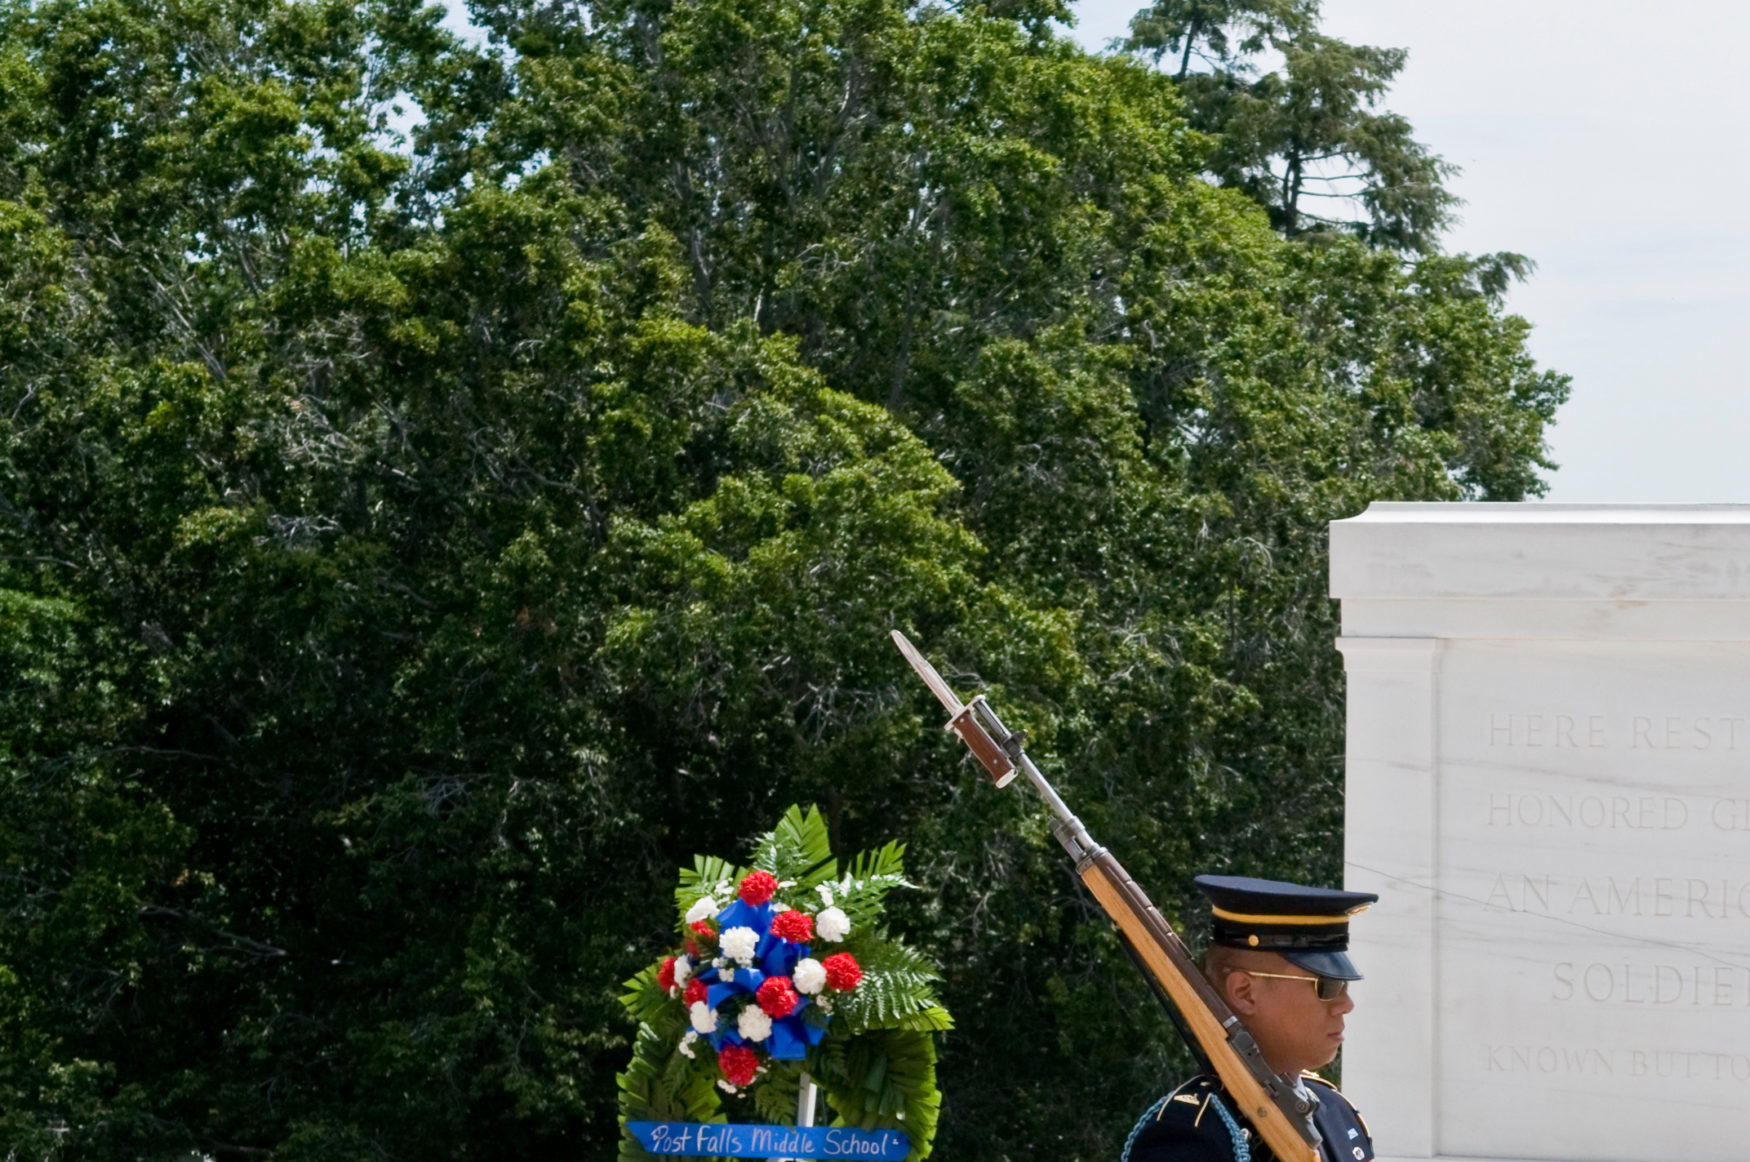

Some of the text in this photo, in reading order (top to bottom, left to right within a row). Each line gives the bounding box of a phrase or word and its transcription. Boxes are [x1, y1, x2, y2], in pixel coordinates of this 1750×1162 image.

[1488, 713, 1607, 749] HERE
[1487, 793, 1689, 830] HONORED
[1483, 872, 1551, 913] AN
[1484, 1045, 1614, 1075] KNOWN
[1629, 1049, 1698, 1079] BUT
[650, 1124, 889, 1156] Post Falls Middle School
